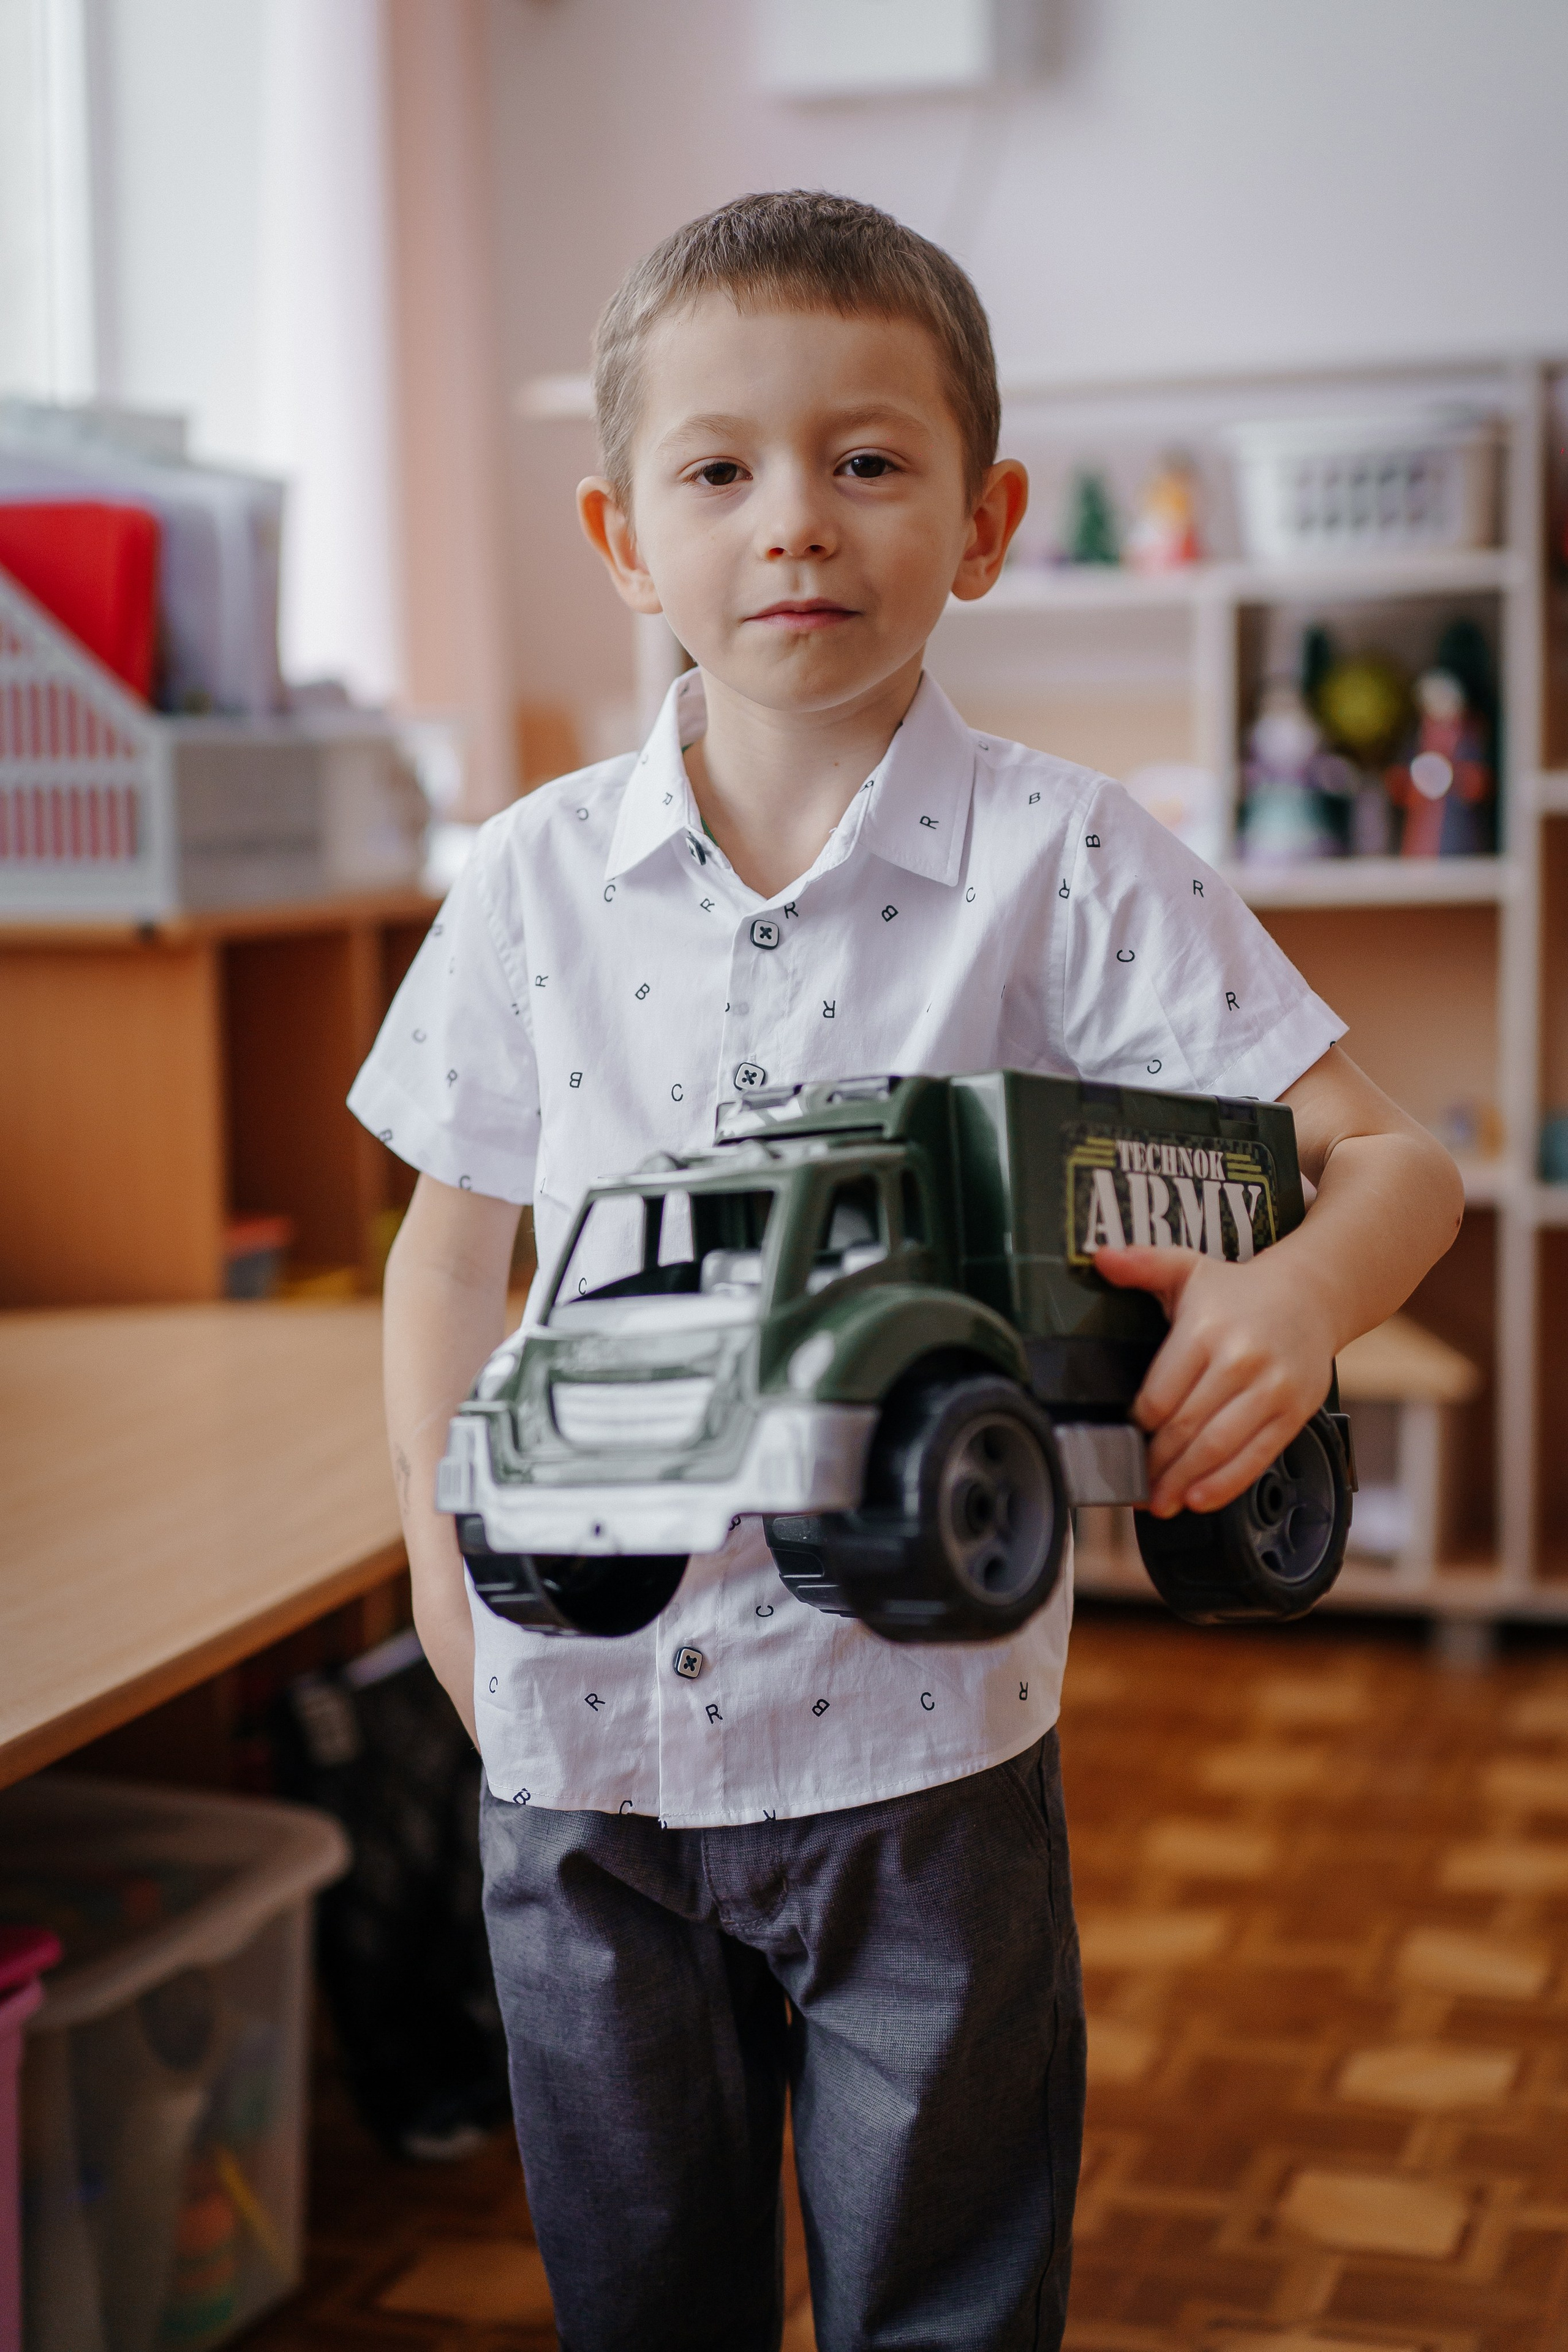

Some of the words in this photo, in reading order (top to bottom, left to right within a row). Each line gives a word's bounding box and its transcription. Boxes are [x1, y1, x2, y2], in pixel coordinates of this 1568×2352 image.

[1029, 793, 1040, 804] B
[919, 816, 939, 829] R
[1085, 834, 1101, 848] B
[604, 885, 616, 902] C
[966, 887, 975, 902] C
[1193, 880, 1204, 897] R
[700, 899, 715, 912] R
[784, 902, 798, 919] R
[881, 905, 899, 922] B
[1117, 950, 1135, 962] C
[535, 976, 548, 987] R
[635, 983, 650, 1000] B
[823, 1000, 835, 1018] R
[1226, 992, 1240, 1011] R
[1147, 1060, 1162, 1074] C
[570, 1072, 582, 1088] B
[671, 1084, 683, 1101] C
[1116, 1139, 1226, 1181] TECHNOK
[1082, 1168, 1262, 1263] ARMY
[578, 1277, 587, 1295] C
[756, 1605, 774, 1617] C
[489, 1676, 498, 1694] C
[1019, 1682, 1028, 1700] R
[584, 1694, 605, 1711] R
[812, 1699, 830, 1717] B
[921, 1692, 935, 1711] C
[706, 1704, 723, 1724] R
